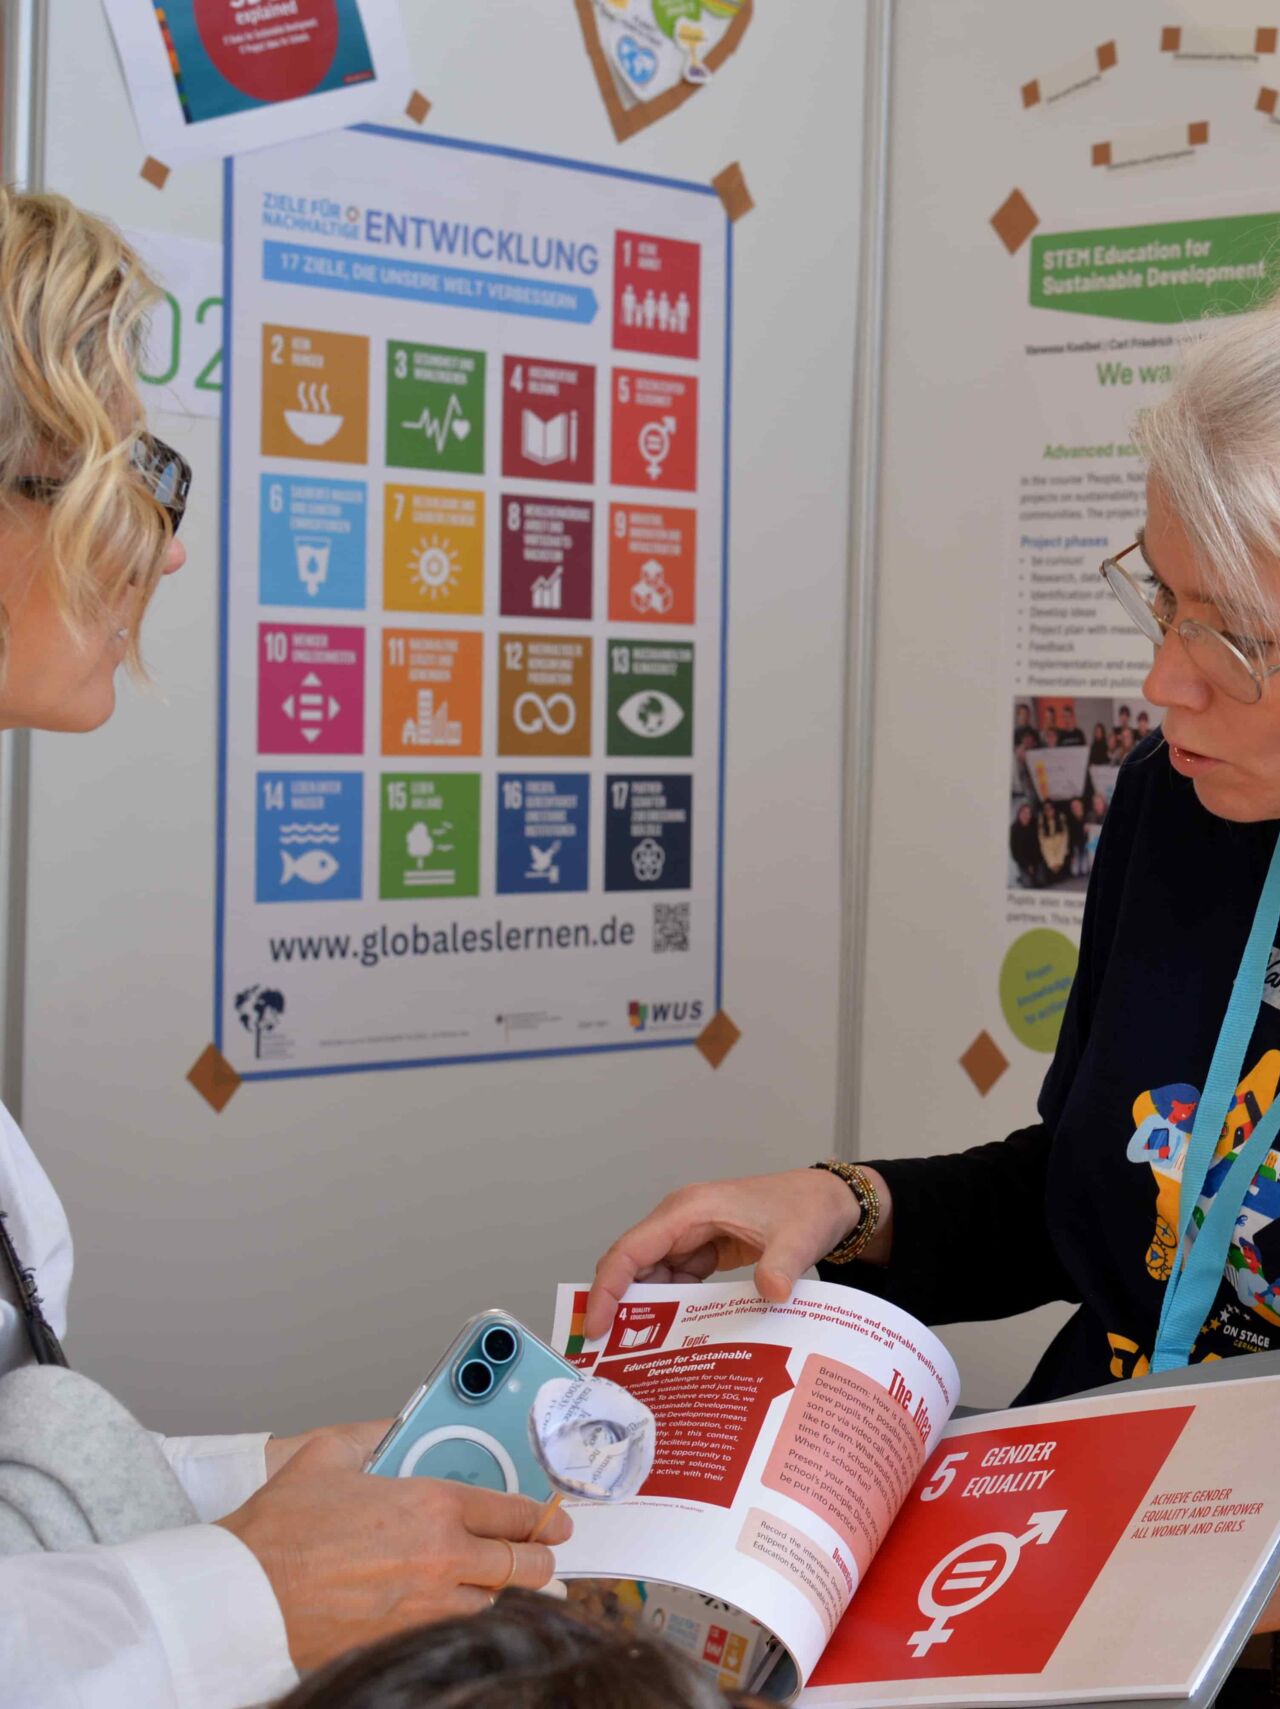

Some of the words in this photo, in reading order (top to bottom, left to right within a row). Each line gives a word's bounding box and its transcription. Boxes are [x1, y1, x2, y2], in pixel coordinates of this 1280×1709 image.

[235, 2, 299, 26] explained
[263, 192, 305, 213] ZIELE
[311, 196, 341, 218] FÜR
[262, 212, 360, 240] NACHHALTIGE
[364, 208, 598, 275] ENTWICKLUNG
[623, 240, 632, 267] 1
[1043, 247, 1091, 270] STEM
[1094, 240, 1181, 266] Education
[1185, 238, 1212, 258] for
[280, 253, 299, 270] 17
[303, 255, 349, 280] ZIELE,
[352, 262, 378, 283] DIE
[380, 267, 440, 292] UNSERE
[444, 275, 483, 297] WELT
[487, 282, 579, 310] VERBESSERN
[1042, 269, 1142, 295] Sustainable
[1147, 260, 1266, 288] Development
[271, 334, 284, 365] 2
[395, 349, 408, 379] 3
[509, 364, 524, 393] 4
[1097, 363, 1133, 386] We
[617, 375, 630, 404] 5
[1043, 443, 1114, 459] Advanced
[269, 483, 283, 513] 6
[393, 492, 406, 522] 7
[507, 502, 521, 531] 8
[614, 510, 627, 539] 9
[1020, 534, 1062, 548] Project
[1064, 535, 1108, 548] phases
[265, 631, 288, 663] 10
[388, 637, 404, 666] 11
[504, 641, 524, 671] 12
[611, 646, 630, 675] 13
[264, 781, 285, 811] 14
[387, 781, 407, 810] 15
[503, 780, 522, 810] 16
[611, 781, 630, 810] 17
[268, 915, 636, 967] www.globaleslernen.de
[652, 1000, 703, 1022] WUS
[619, 1307, 628, 1320] 4
[698, 1310, 733, 1321] promote
[735, 1306, 768, 1315] lifelong
[769, 1306, 807, 1318] learning
[809, 1311, 869, 1336] opportunities
[870, 1331, 884, 1342] for
[884, 1340, 894, 1350] all
[681, 1334, 710, 1348] Topic
[686, 1302, 726, 1314] Quality
[792, 1297, 823, 1309] Ensure
[824, 1303, 863, 1321] inclusive
[864, 1316, 881, 1329] and
[881, 1326, 917, 1354] equitable
[916, 1351, 937, 1377] quality
[1223, 1325, 1239, 1338] ON
[1239, 1330, 1271, 1348] STAGE
[623, 1357, 673, 1373] Education
[673, 1355, 690, 1364] for
[690, 1350, 752, 1362] Sustainable
[647, 1361, 716, 1377] Development
[657, 1384, 699, 1393] sustainable
[734, 1385, 758, 1394] world,
[660, 1375, 699, 1385] challenges
[728, 1374, 755, 1383] future.
[819, 1366, 871, 1398] Brainstorm:
[872, 1393, 891, 1412] How
[667, 1393, 697, 1401] achieve
[693, 1401, 749, 1412] Development.
[815, 1377, 875, 1415] Development
[888, 1368, 912, 1410] The
[913, 1397, 932, 1445] Idea
[667, 1411, 719, 1419] Development
[720, 1413, 747, 1422] means
[668, 1420, 722, 1430] collaboration,
[806, 1401, 824, 1413] son
[837, 1415, 850, 1427] via
[851, 1423, 872, 1444] video
[811, 1389, 833, 1404] view
[834, 1400, 862, 1421] pupils
[862, 1416, 880, 1435] from
[706, 1432, 740, 1442] context,
[798, 1423, 820, 1439] time
[822, 1434, 836, 1447] for
[847, 1451, 874, 1478] school?
[802, 1411, 819, 1425] like
[831, 1425, 854, 1445] learn.
[855, 1442, 875, 1462] What
[671, 1450, 721, 1461] opportunity
[688, 1460, 728, 1472] solutions.
[788, 1448, 823, 1472] Present
[824, 1469, 844, 1486] your
[794, 1434, 821, 1454] When
[831, 1455, 858, 1479] school
[858, 1474, 872, 1493] fun?
[920, 1452, 969, 1502] 5
[981, 1441, 1057, 1468] GENDER
[961, 1469, 1056, 1499] EQUALITY
[779, 1472, 793, 1484] be
[793, 1480, 811, 1494] put
[811, 1490, 828, 1506] into
[828, 1503, 857, 1535] practice!
[820, 1483, 854, 1514] principle.
[1150, 1491, 1192, 1506] ACHIEVE
[1191, 1488, 1233, 1502] GENDER
[1141, 1507, 1190, 1523] EQUALITY
[1188, 1506, 1211, 1519] AND
[1212, 1502, 1264, 1517] EMPOWER
[760, 1520, 788, 1540] Record
[789, 1537, 801, 1548] the
[1131, 1526, 1150, 1539] ALL
[1151, 1523, 1191, 1538] WOMEN
[1190, 1522, 1213, 1535] AND
[1214, 1520, 1245, 1533] GIRLS
[752, 1541, 790, 1567] Education
[789, 1562, 800, 1574] for
[757, 1532, 788, 1553] snippets
[789, 1549, 805, 1566] from
